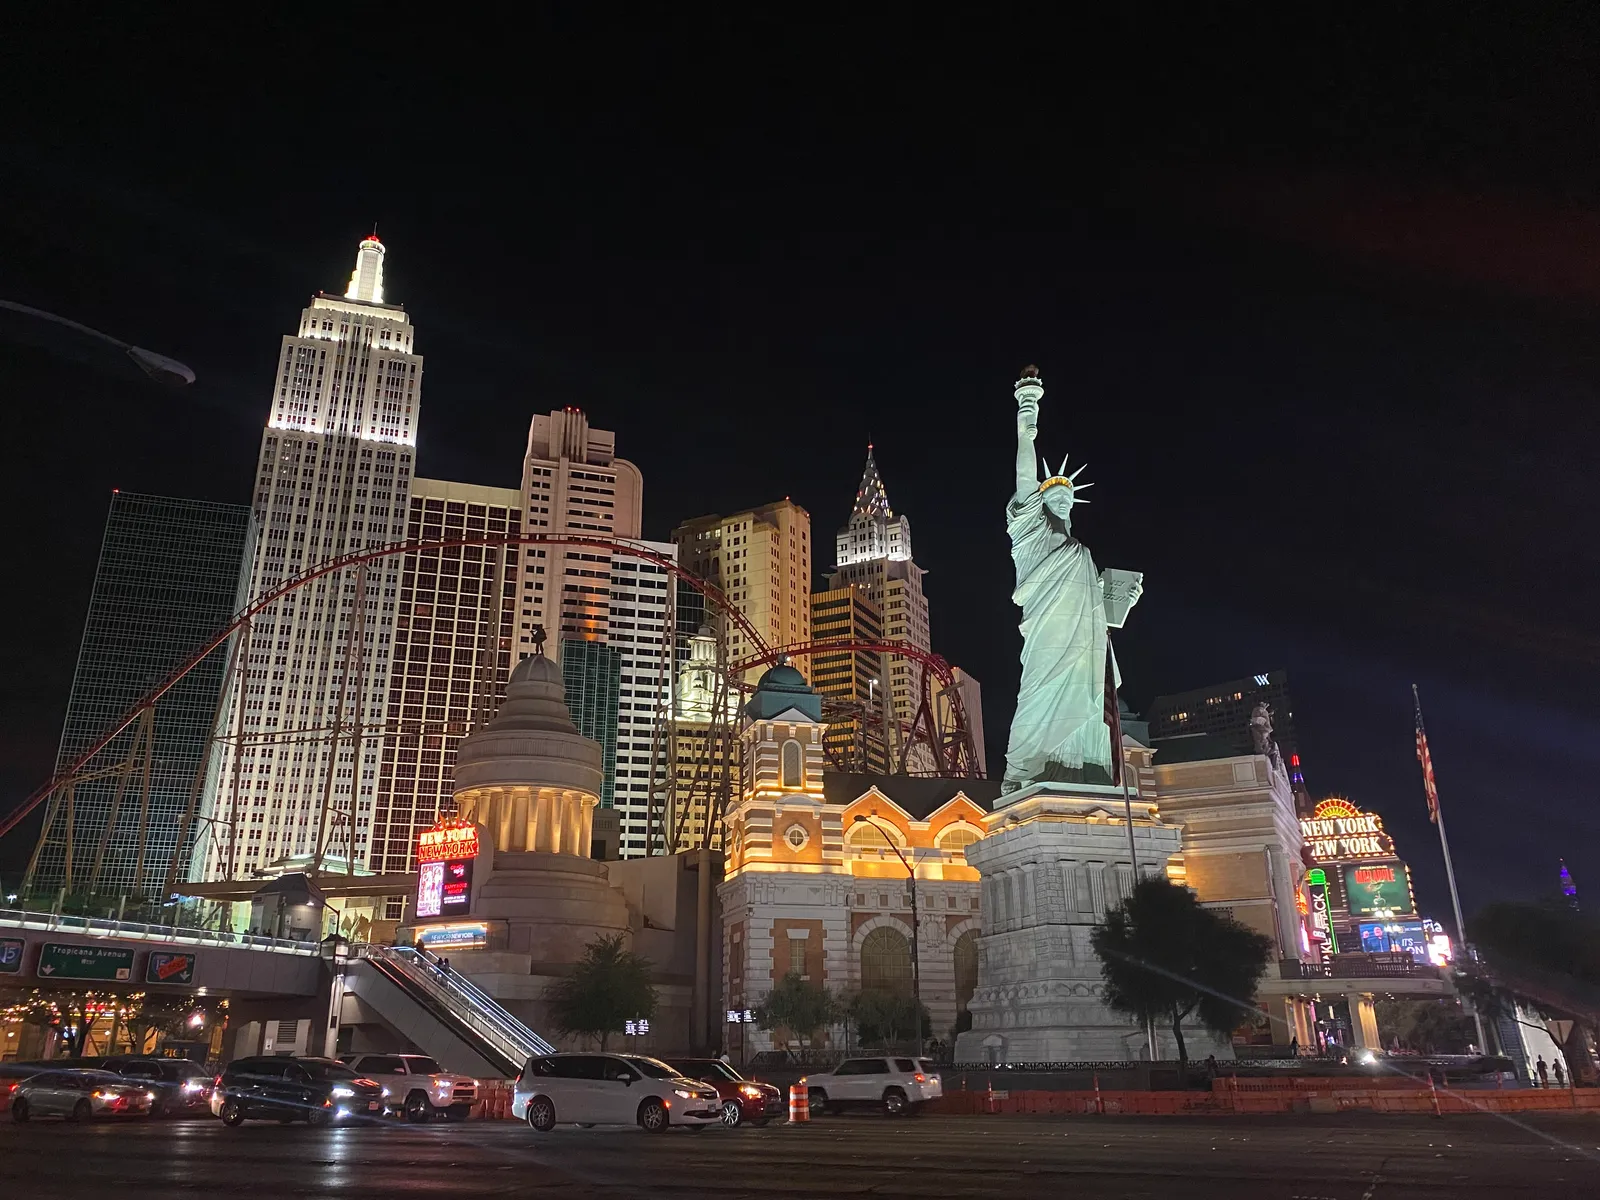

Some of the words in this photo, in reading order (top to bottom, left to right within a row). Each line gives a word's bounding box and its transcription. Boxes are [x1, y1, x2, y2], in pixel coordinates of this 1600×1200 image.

[1300, 819, 1334, 837] NEW
[1336, 816, 1380, 834] YORK
[420, 829, 444, 846] NEW
[445, 827, 475, 842] YORK
[1340, 836, 1384, 854] YORK
[419, 843, 444, 860] NEW
[444, 841, 475, 856] YORK
[52, 946, 93, 956] Tropicana
[96, 949, 127, 958] Avenue
